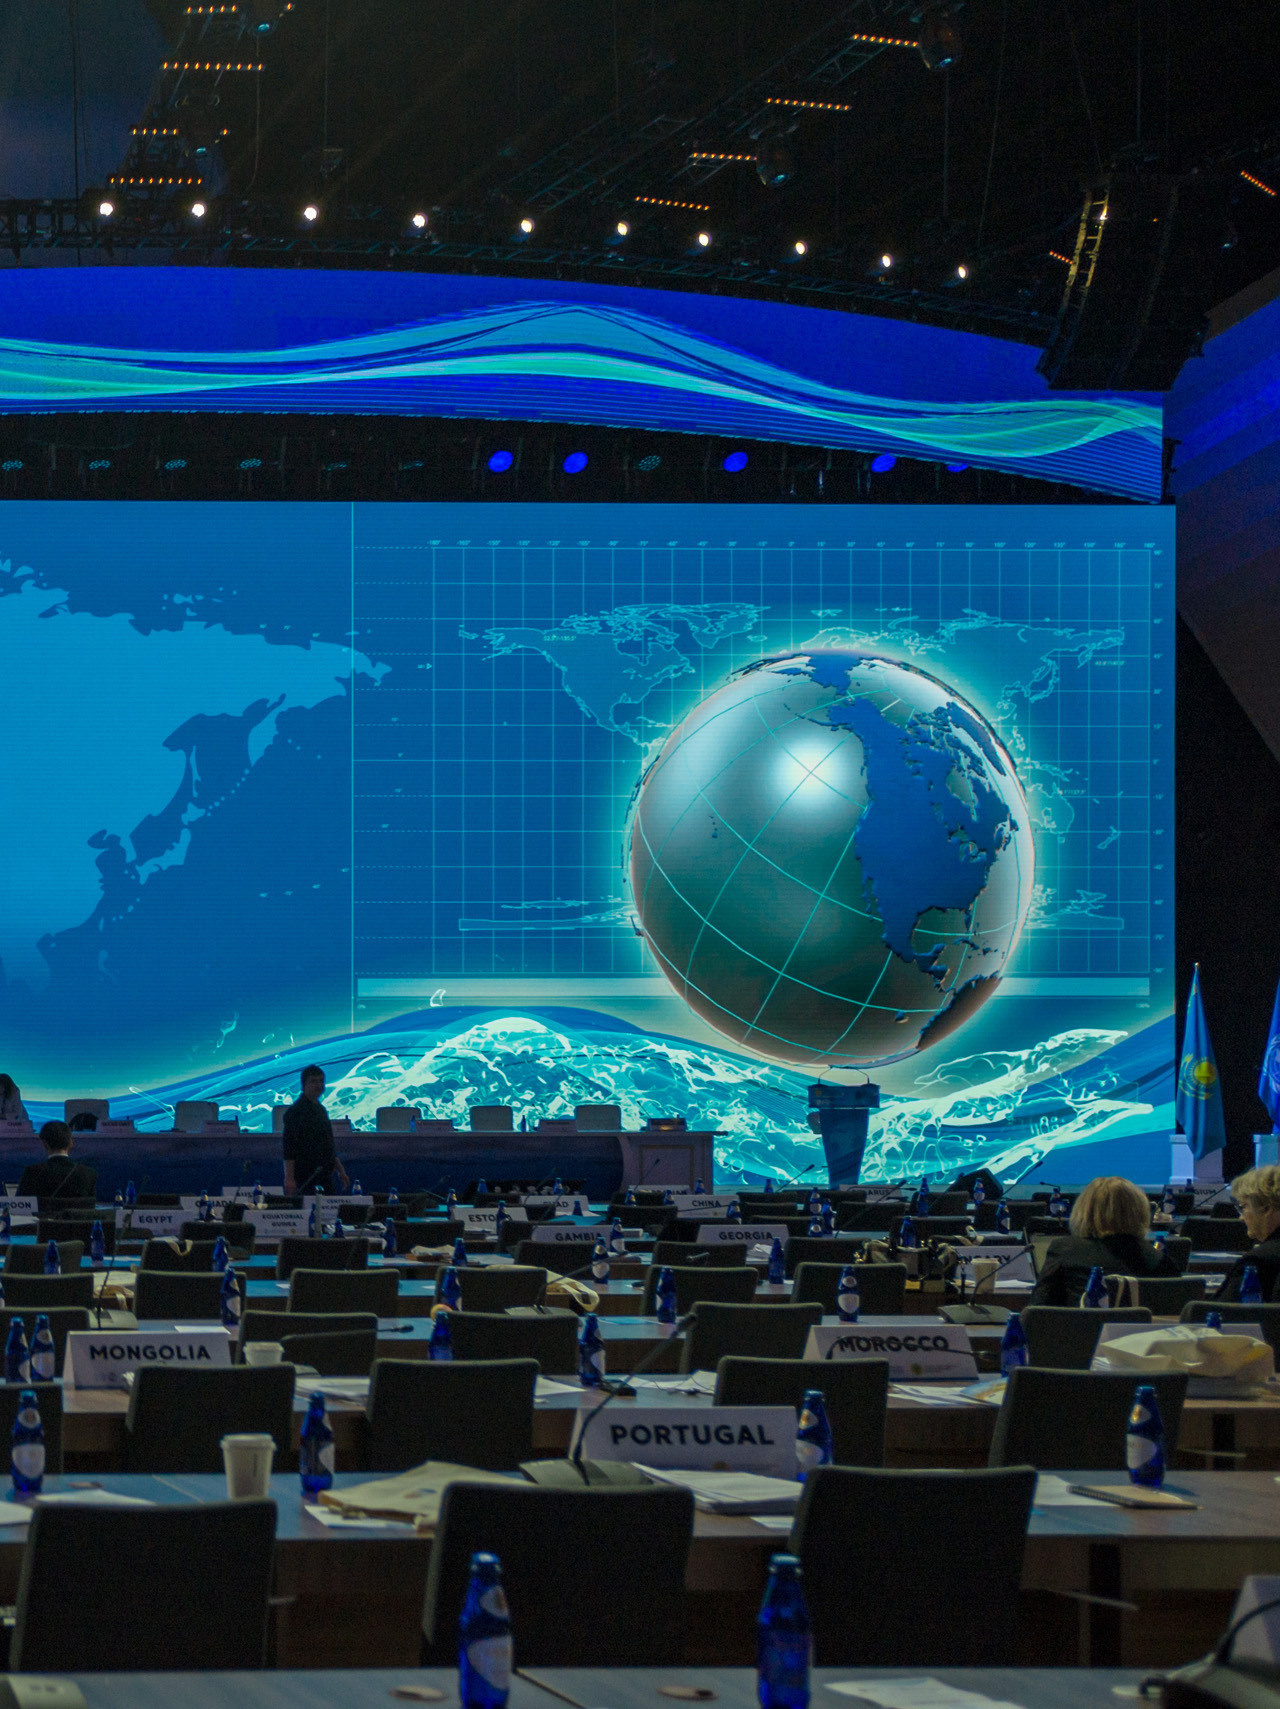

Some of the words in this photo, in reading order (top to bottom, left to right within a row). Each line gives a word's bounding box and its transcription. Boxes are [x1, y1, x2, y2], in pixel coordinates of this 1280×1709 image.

[139, 1216, 173, 1224] EGYPT
[719, 1231, 773, 1240] GEORGIA
[837, 1335, 949, 1352] MOROCCO
[89, 1344, 211, 1360] MONGOLIA
[610, 1424, 775, 1445] PORTUGAL
